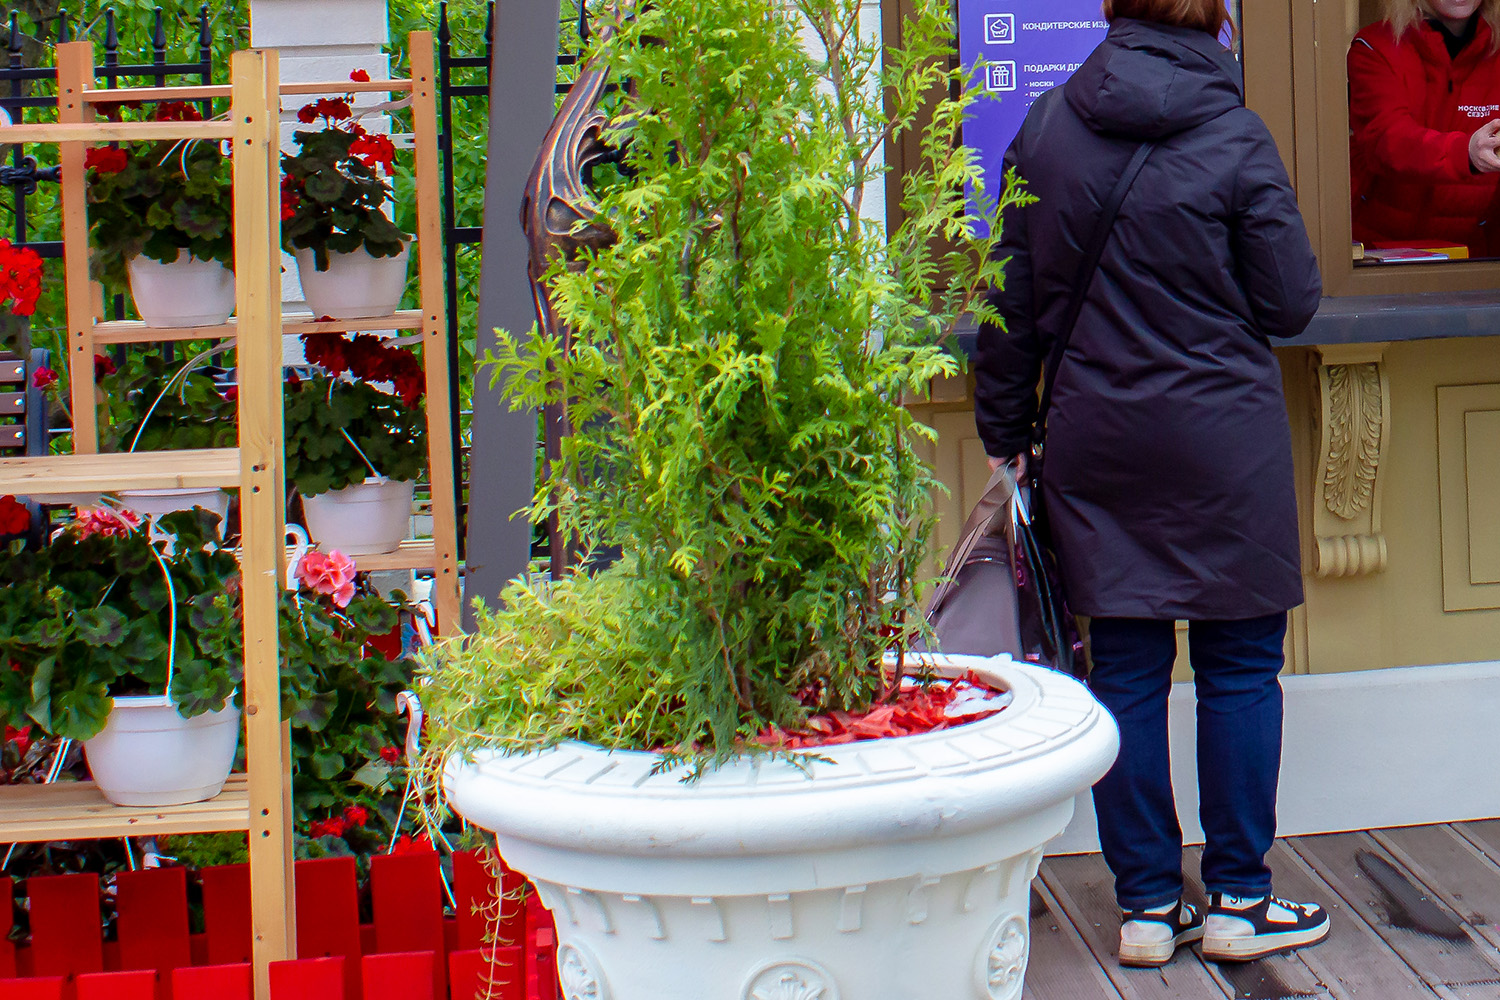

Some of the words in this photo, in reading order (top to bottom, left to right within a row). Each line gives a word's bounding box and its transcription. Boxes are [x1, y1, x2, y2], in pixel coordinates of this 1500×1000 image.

[1022, 21, 1091, 31] КОНДИТЕРСКИЕ
[1092, 20, 1110, 29] ИЗД
[1024, 64, 1065, 73] ПОДАРКИ
[1067, 63, 1083, 71] ДЛ
